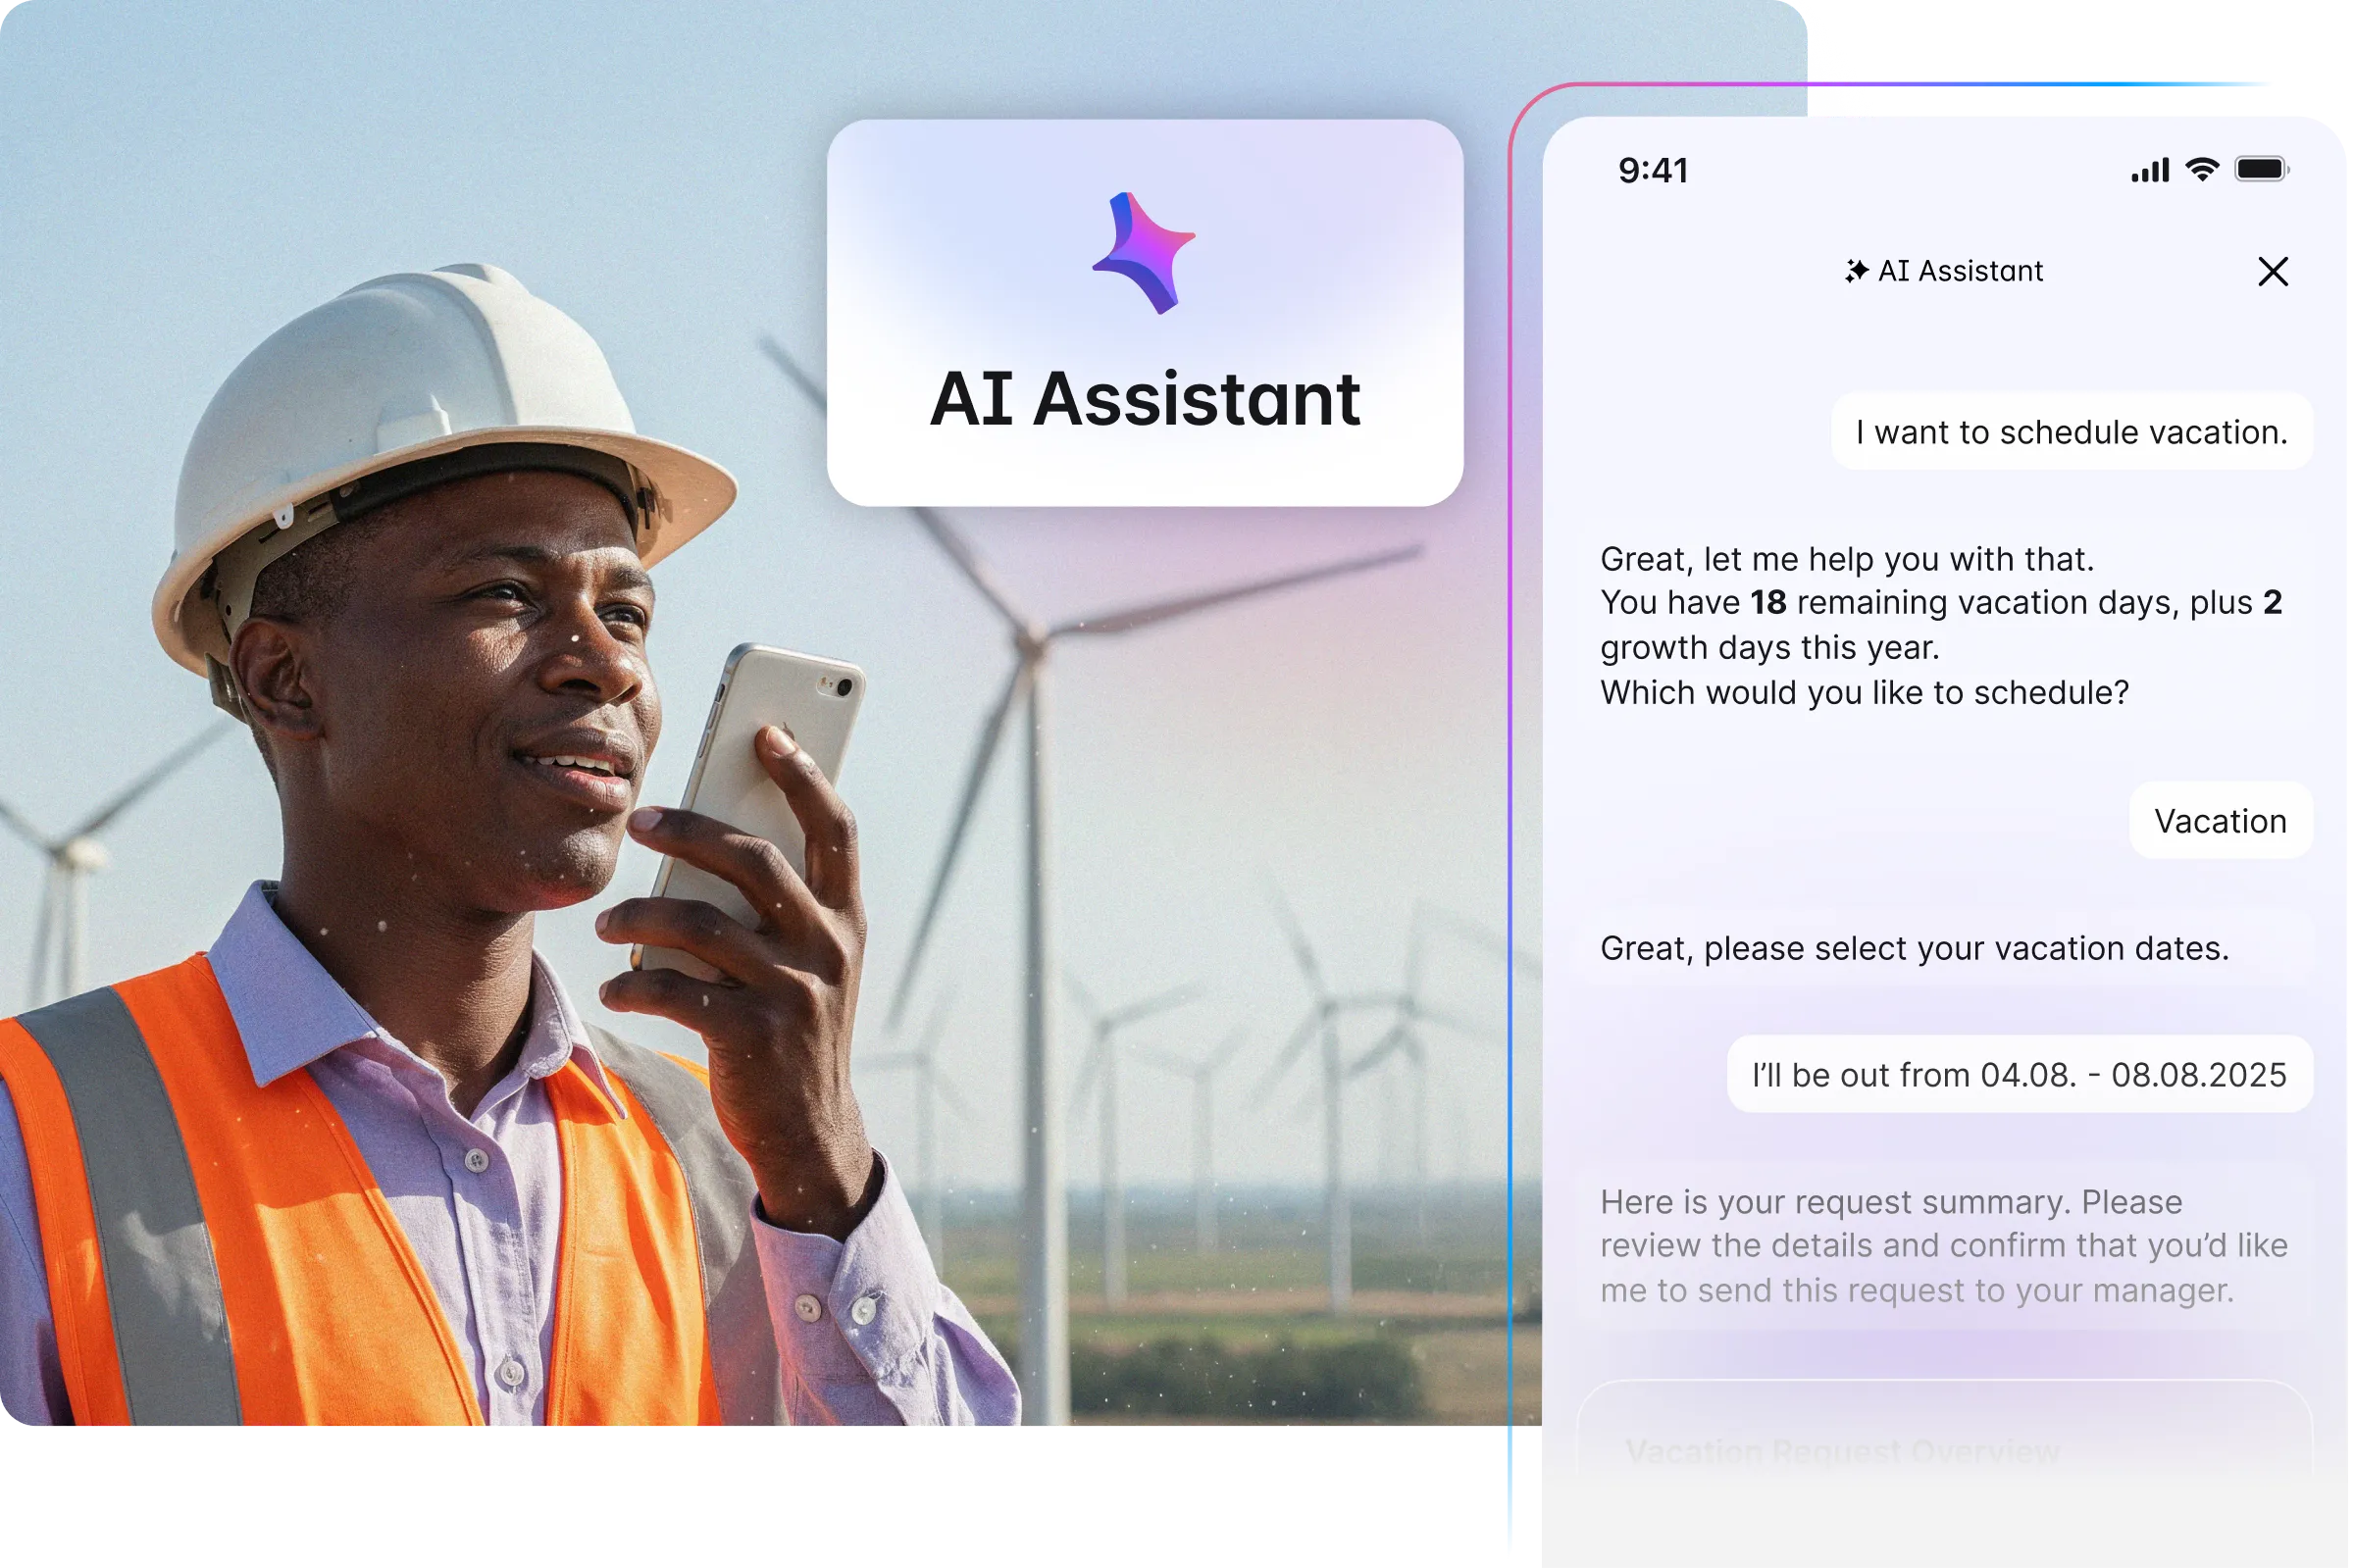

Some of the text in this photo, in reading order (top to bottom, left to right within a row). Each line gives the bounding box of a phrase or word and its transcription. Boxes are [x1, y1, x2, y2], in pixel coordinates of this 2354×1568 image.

[1618, 156, 1687, 184] 9:41
[1878, 258, 2044, 282] AI Assistant
[1857, 418, 2287, 446] I want to schedule vacation.
[1601, 545, 2094, 579] Great, let me help you with that.
[1601, 588, 2282, 622] You have 18 remaining vacation days, plus 2
[1601, 633, 1939, 667] growth days this year.
[1600, 679, 2129, 712] Which would you like to schedule?
[2154, 807, 2286, 835] Vacation
[1601, 934, 2229, 968] Great, please select your vacation dates.
[1793, 1062, 1830, 1088] be
[1840, 1063, 1890, 1088] out
[1899, 1060, 1970, 1088] from
[1981, 1061, 2076, 1088] 04.08.
[2112, 1061, 2287, 1088] 08.08.2025
[1602, 1188, 2183, 1221] Here is your request summary. Please
[1602, 1231, 1702, 1258] review
[1711, 1232, 1762, 1258] the
[1771, 1231, 1872, 1258] details
[1883, 1232, 1939, 1258] and
[1950, 1231, 2066, 1258] confirm
[2075, 1232, 2137, 1258] that
[2238, 1231, 2288, 1258] like
[1602, 1276, 2233, 1310] me to send this request to your manager.
[1625, 1438, 2061, 1471] Vacation Request Overview
